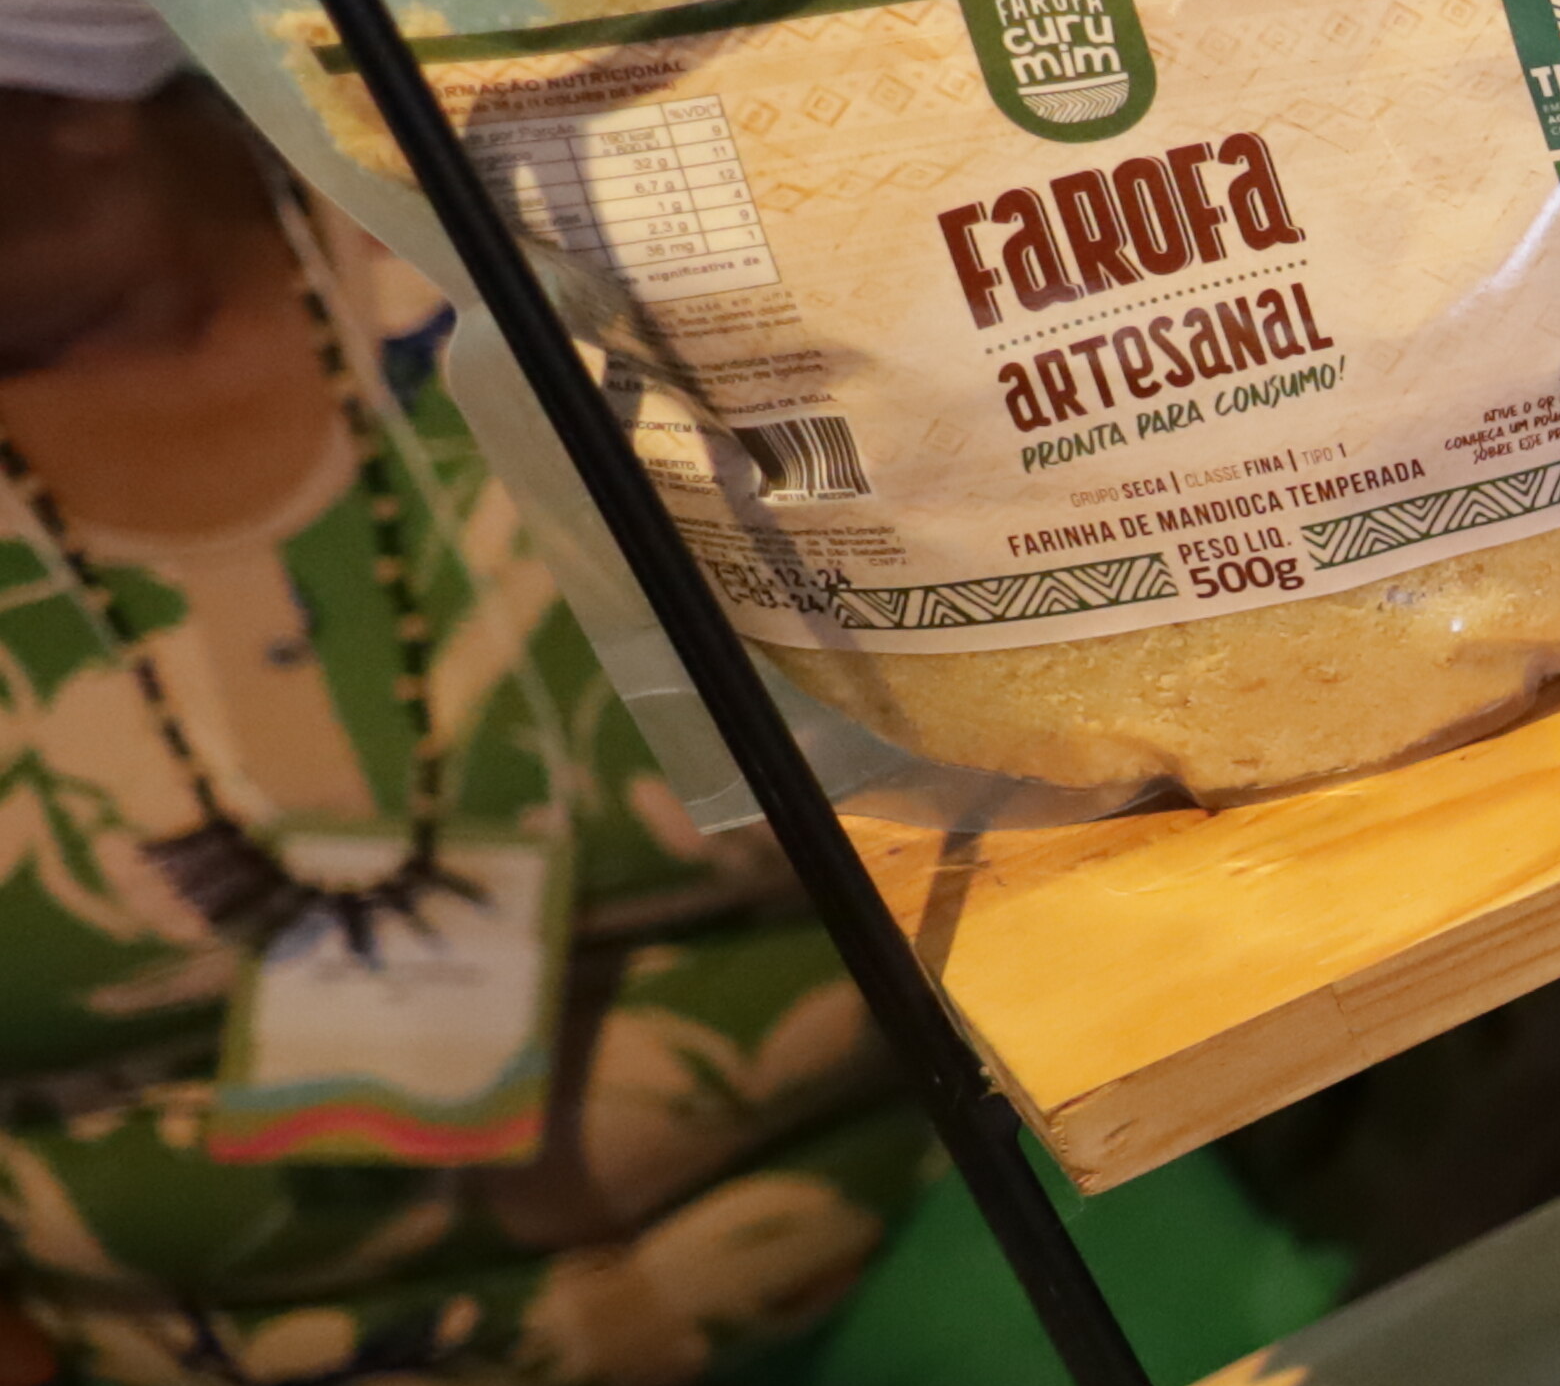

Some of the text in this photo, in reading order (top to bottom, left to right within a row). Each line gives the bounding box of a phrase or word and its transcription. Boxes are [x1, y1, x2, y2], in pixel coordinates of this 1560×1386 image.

[1002, 13, 1115, 55] curu
[549, 60, 687, 92] NUTRICIONAL
[1009, 44, 1122, 85] mim
[633, 156, 655, 171] 32
[647, 255, 761, 284] significativa de
[1021, 355, 1346, 474] PRONTA PARA CONSUMO!
[1444, 427, 1506, 451] CONHEÇA
[1508, 419, 1530, 435] UM
[1473, 443, 1514, 465] SOBRE
[1518, 434, 1543, 451] ESSE
[1071, 442, 1347, 509] GRUPO SECA CLASSE FINA TIPO 1
[1008, 458, 1427, 558] FARINHA DE MANDIOCA TEMPERADA
[1177, 525, 1292, 565] PESO LIQ.
[1189, 556, 1305, 600] 500g
